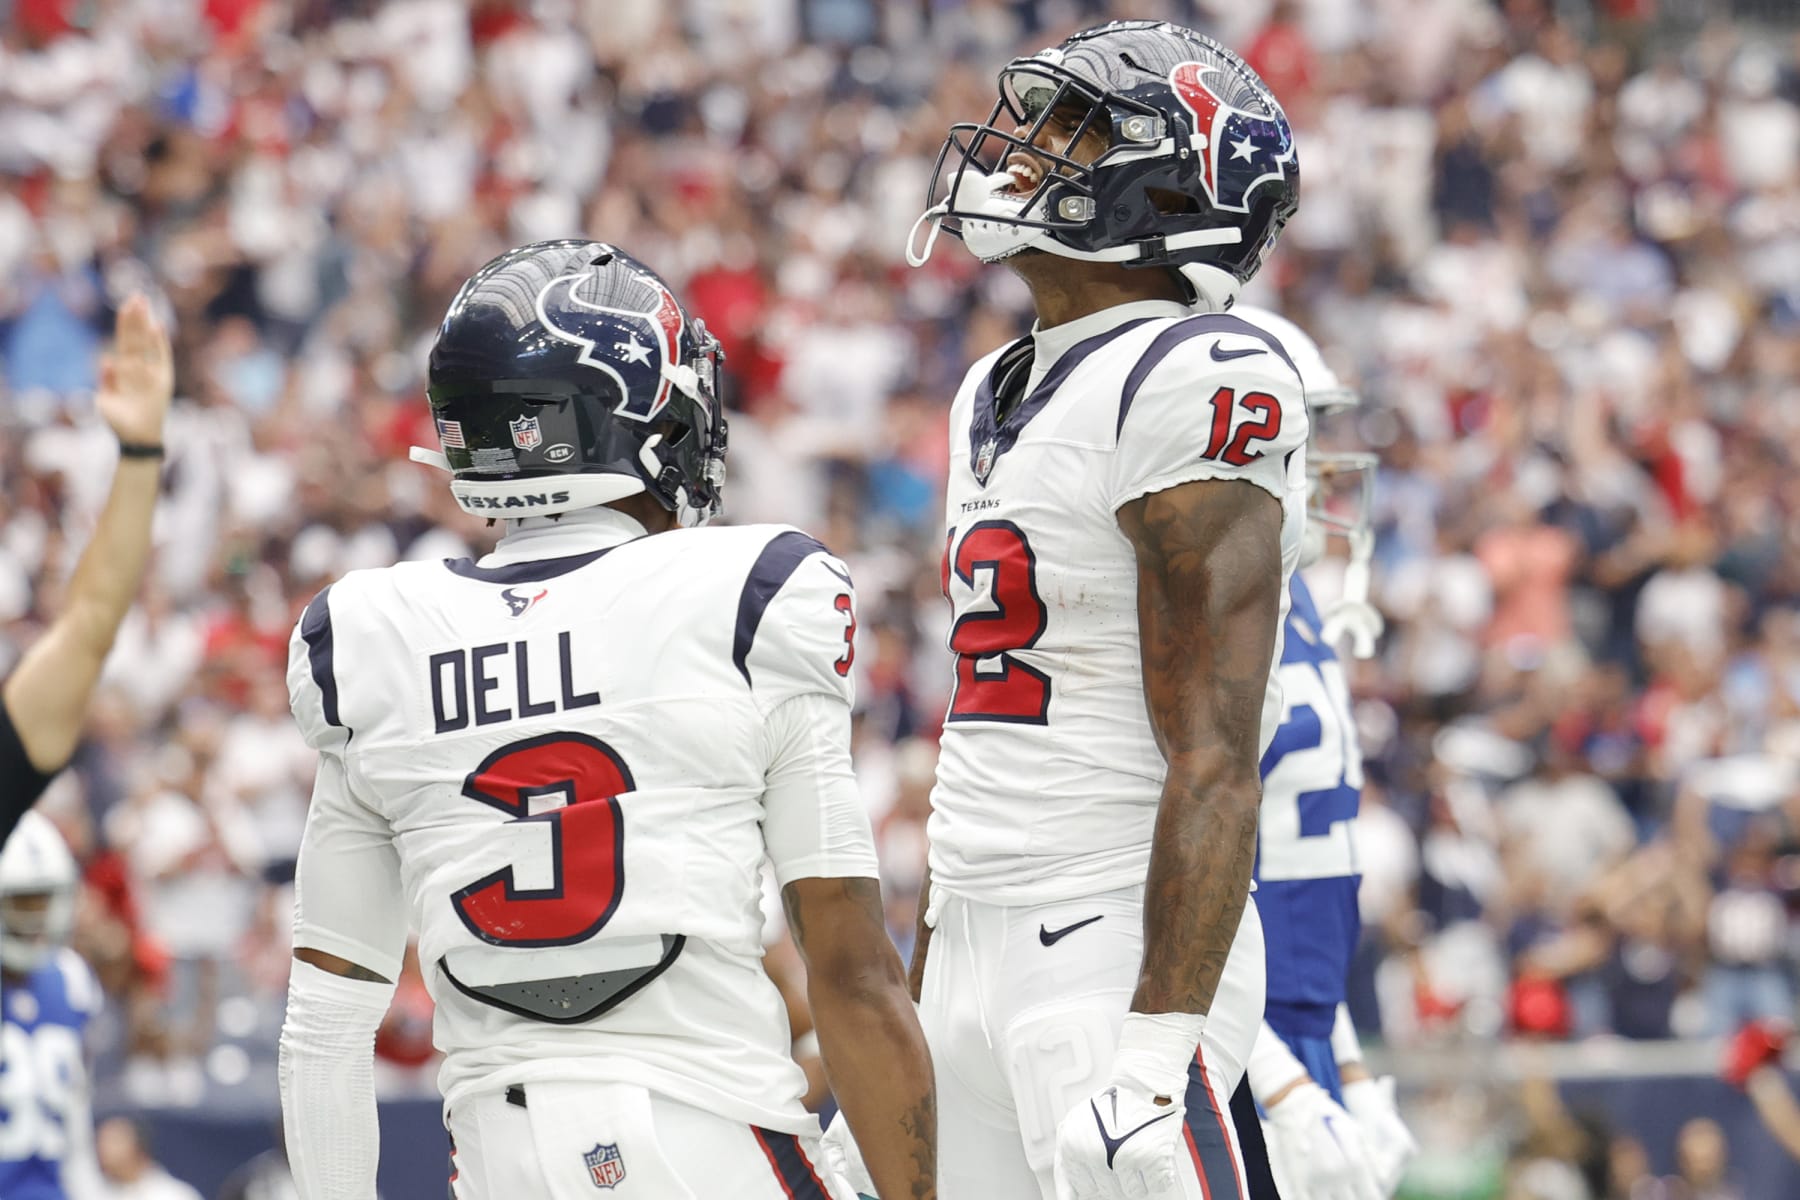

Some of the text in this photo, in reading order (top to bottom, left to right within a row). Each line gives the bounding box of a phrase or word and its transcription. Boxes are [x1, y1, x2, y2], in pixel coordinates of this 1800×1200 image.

[516, 431, 538, 445] NFL
[1201, 386, 1282, 467] 12
[458, 490, 571, 509] TEXANS
[960, 499, 1001, 514] TEXANS
[834, 593, 857, 678] 3
[941, 519, 1052, 726] 2
[430, 631, 601, 735] DELL
[450, 731, 637, 948] 3
[592, 1161, 623, 1185] NFL
